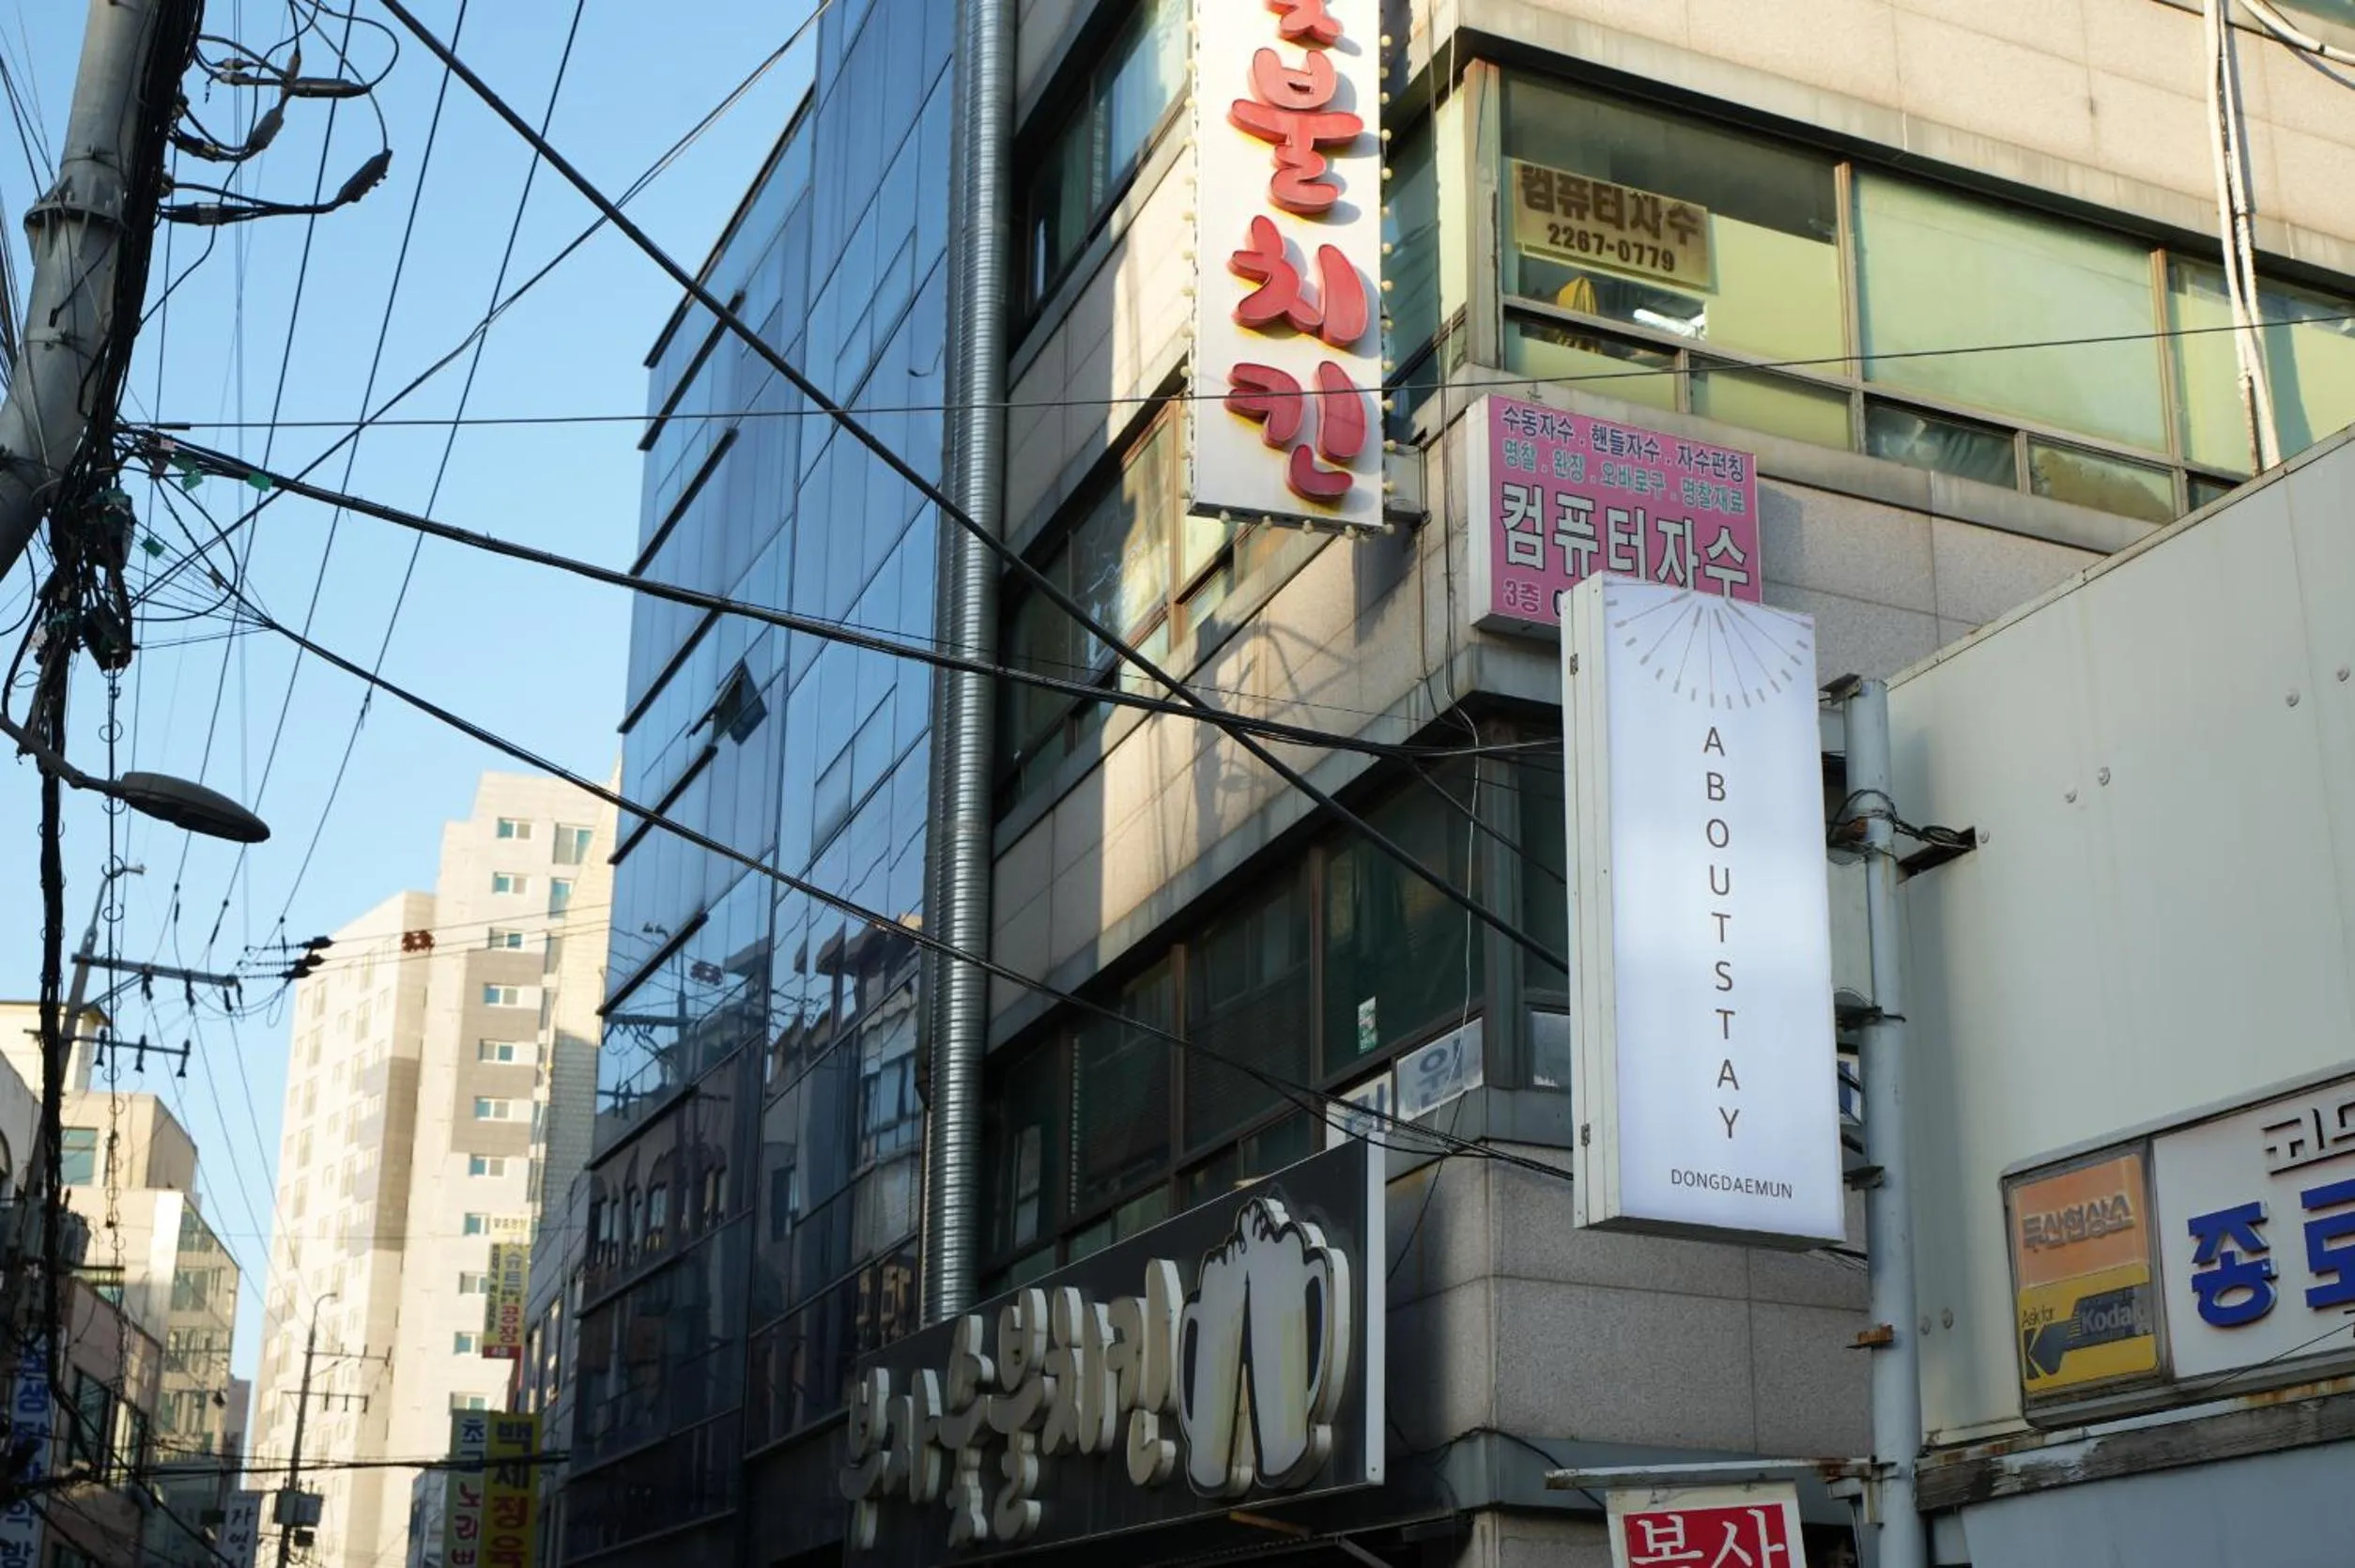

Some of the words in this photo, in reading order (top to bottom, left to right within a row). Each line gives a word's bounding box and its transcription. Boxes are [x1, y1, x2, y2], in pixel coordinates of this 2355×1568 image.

[1520, 163, 1701, 246] 컴퓨터자수
[1547, 223, 1675, 273] 2267-0779
[1501, 405, 1575, 444] 수동자수
[1677, 444, 1745, 484] 자수펀칭
[1503, 438, 1537, 472] 명찰
[1553, 449, 1585, 483] 완장
[1681, 477, 1746, 514] 명찰재료
[1501, 481, 1750, 602] 컴퓨터자수
[1503, 578, 1542, 613] 3층
[1670, 1168, 1793, 1199] DONGDAEMUN
